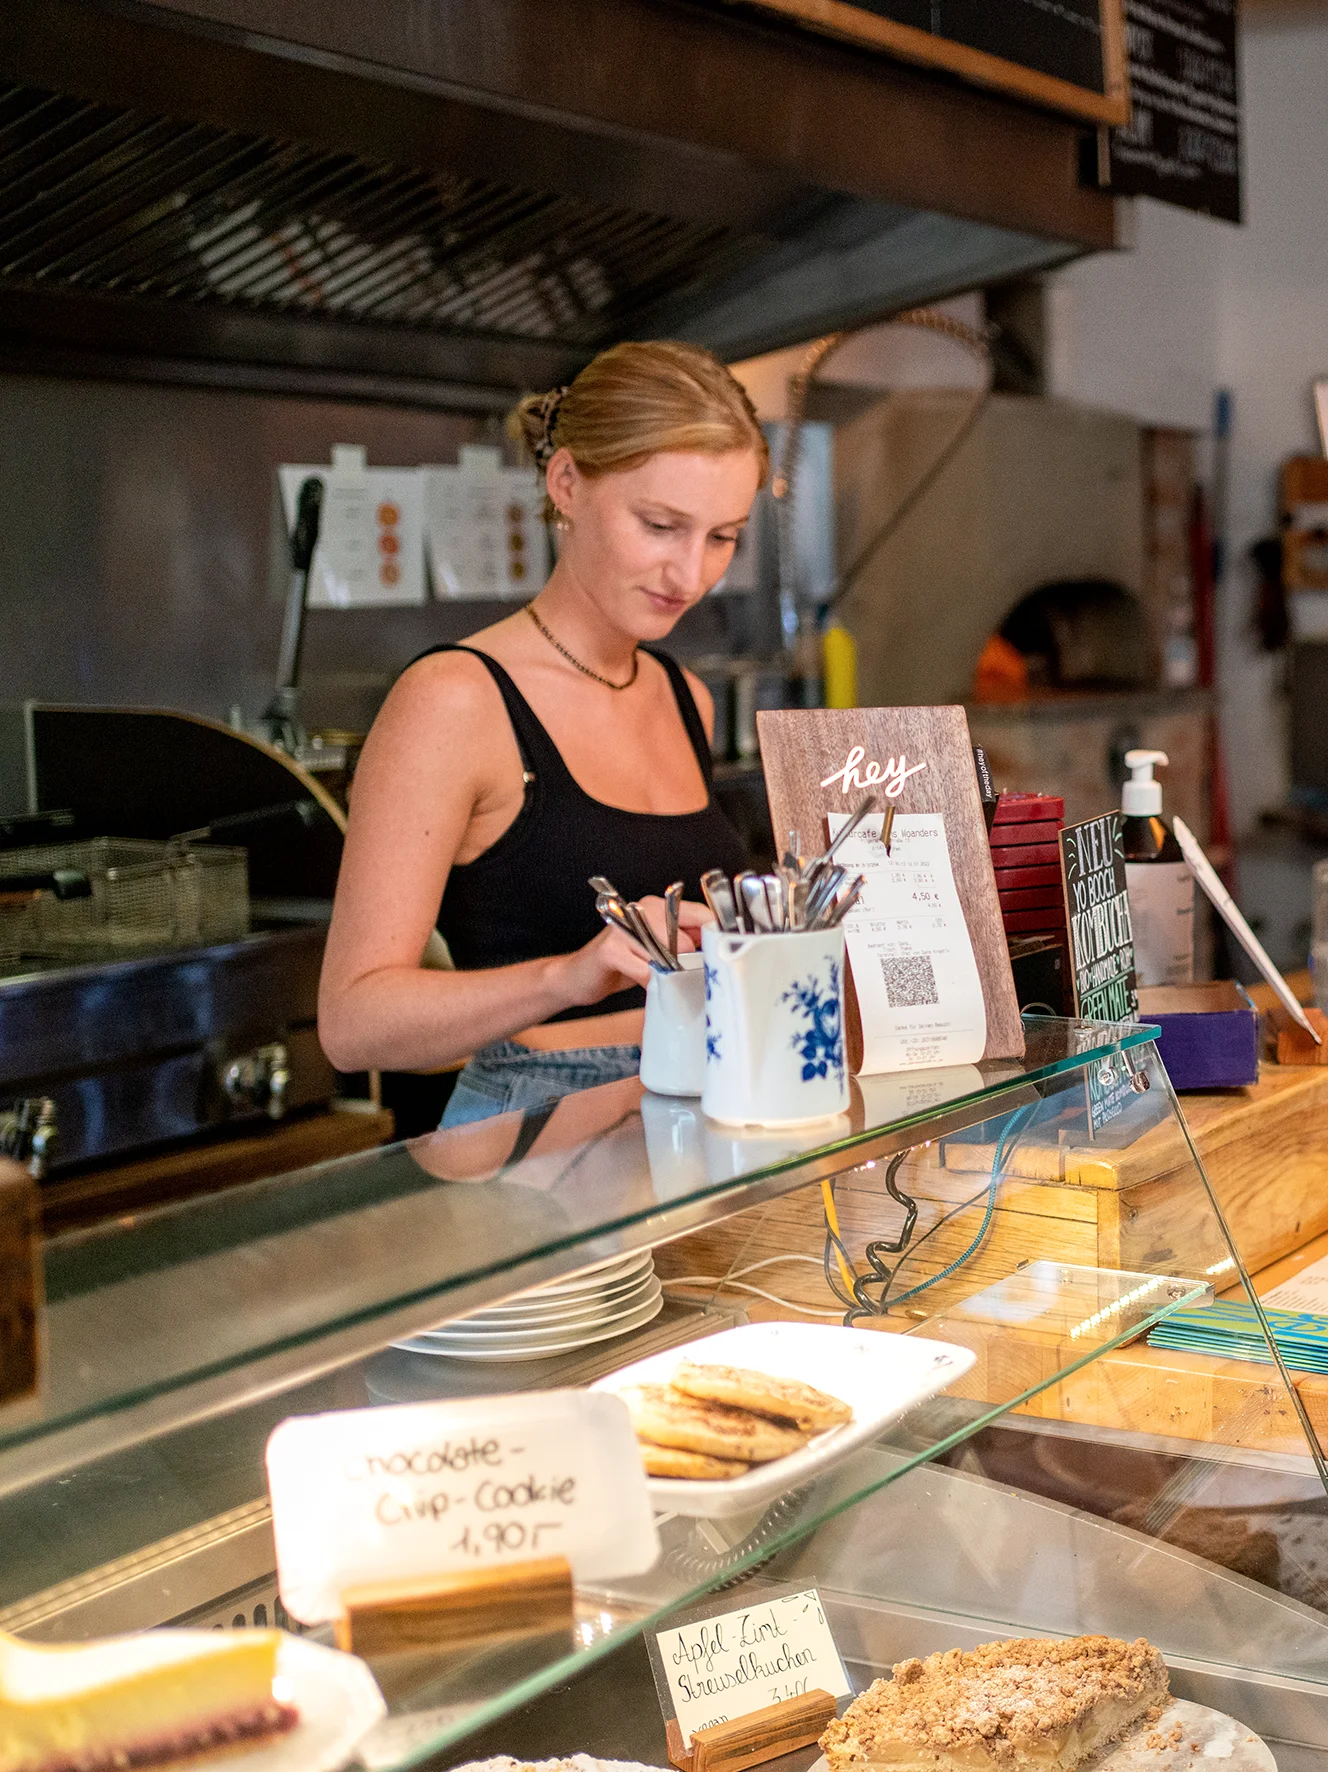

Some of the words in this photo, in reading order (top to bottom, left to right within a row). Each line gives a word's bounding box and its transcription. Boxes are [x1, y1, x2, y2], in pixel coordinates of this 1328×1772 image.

[820, 746, 927, 798] hey
[901, 829, 938, 838] Woanders
[1075, 816, 1113, 876] NEU
[912, 891, 931, 901] 4,50
[1073, 882, 1086, 912] YO
[1087, 867, 1116, 906] BOOCH
[1071, 890, 1133, 970] KOMBUCHA
[678, 1642, 818, 1703] Streuselkuchen
